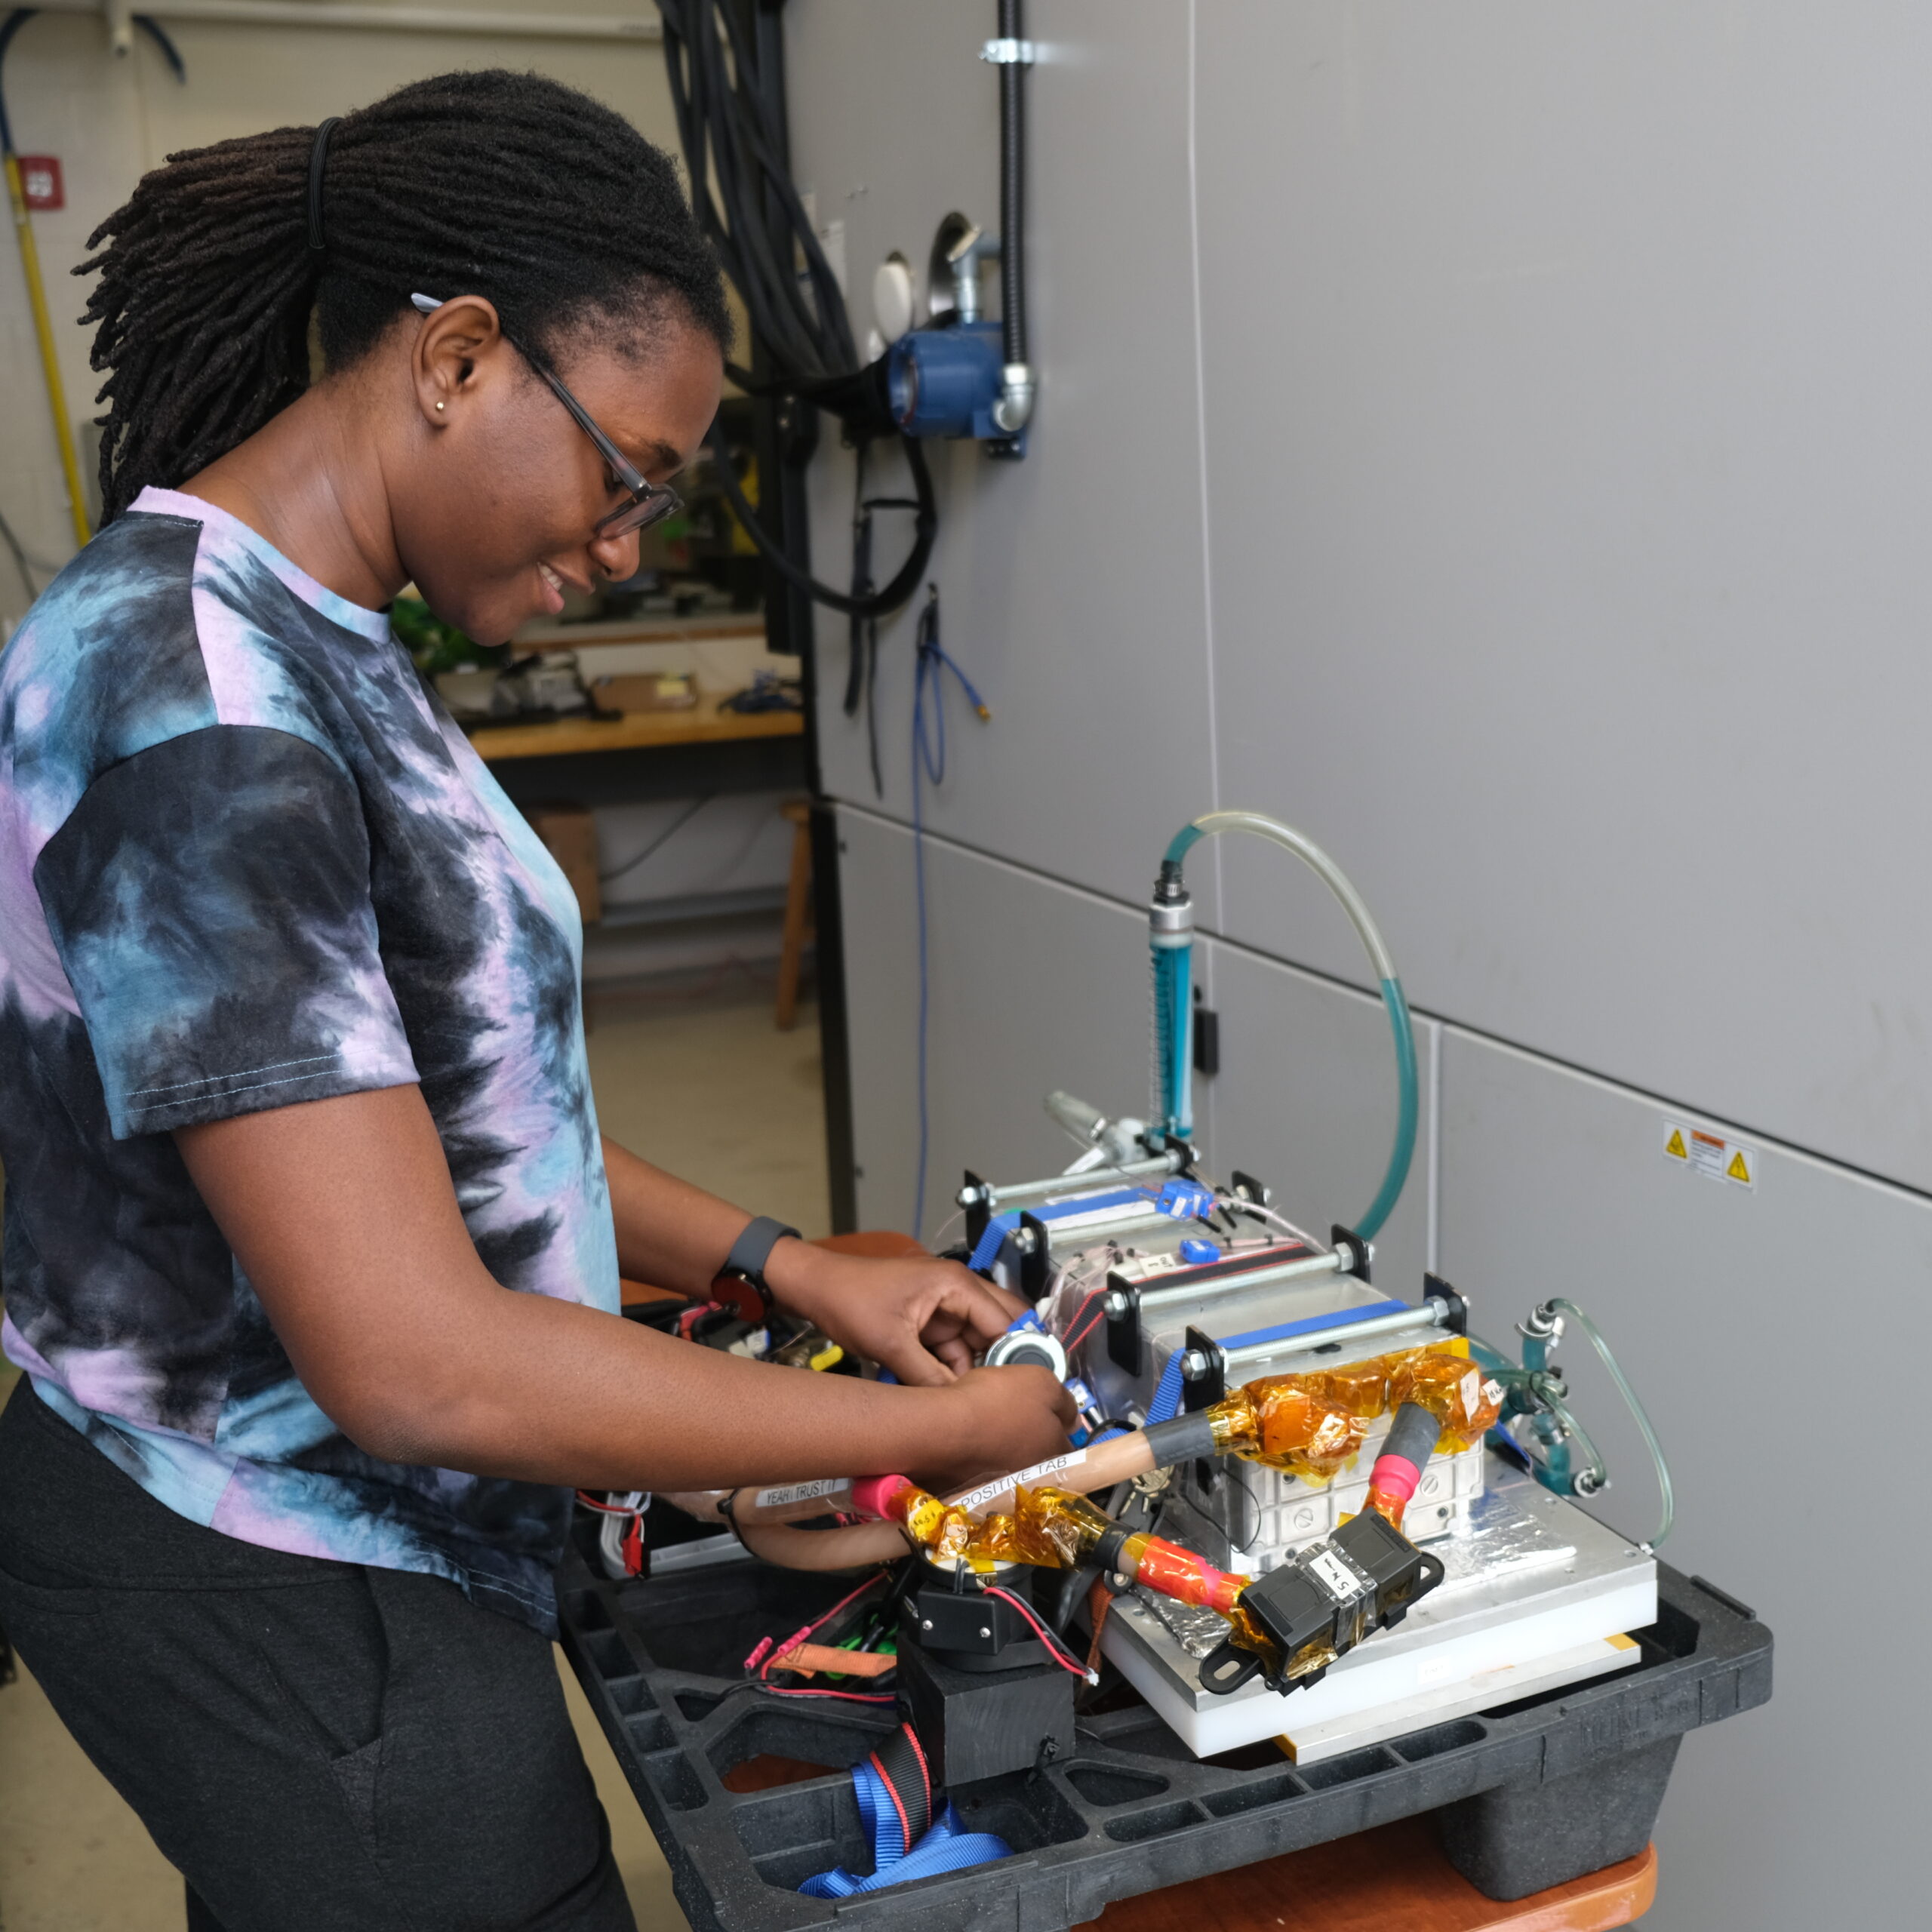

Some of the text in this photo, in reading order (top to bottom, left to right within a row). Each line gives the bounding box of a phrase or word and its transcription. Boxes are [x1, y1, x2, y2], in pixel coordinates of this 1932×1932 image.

[767, 1490, 789, 1504] YEAH
[795, 1481, 826, 1499] TRUST
[961, 1457, 1068, 1507] POSITIVE TAB
